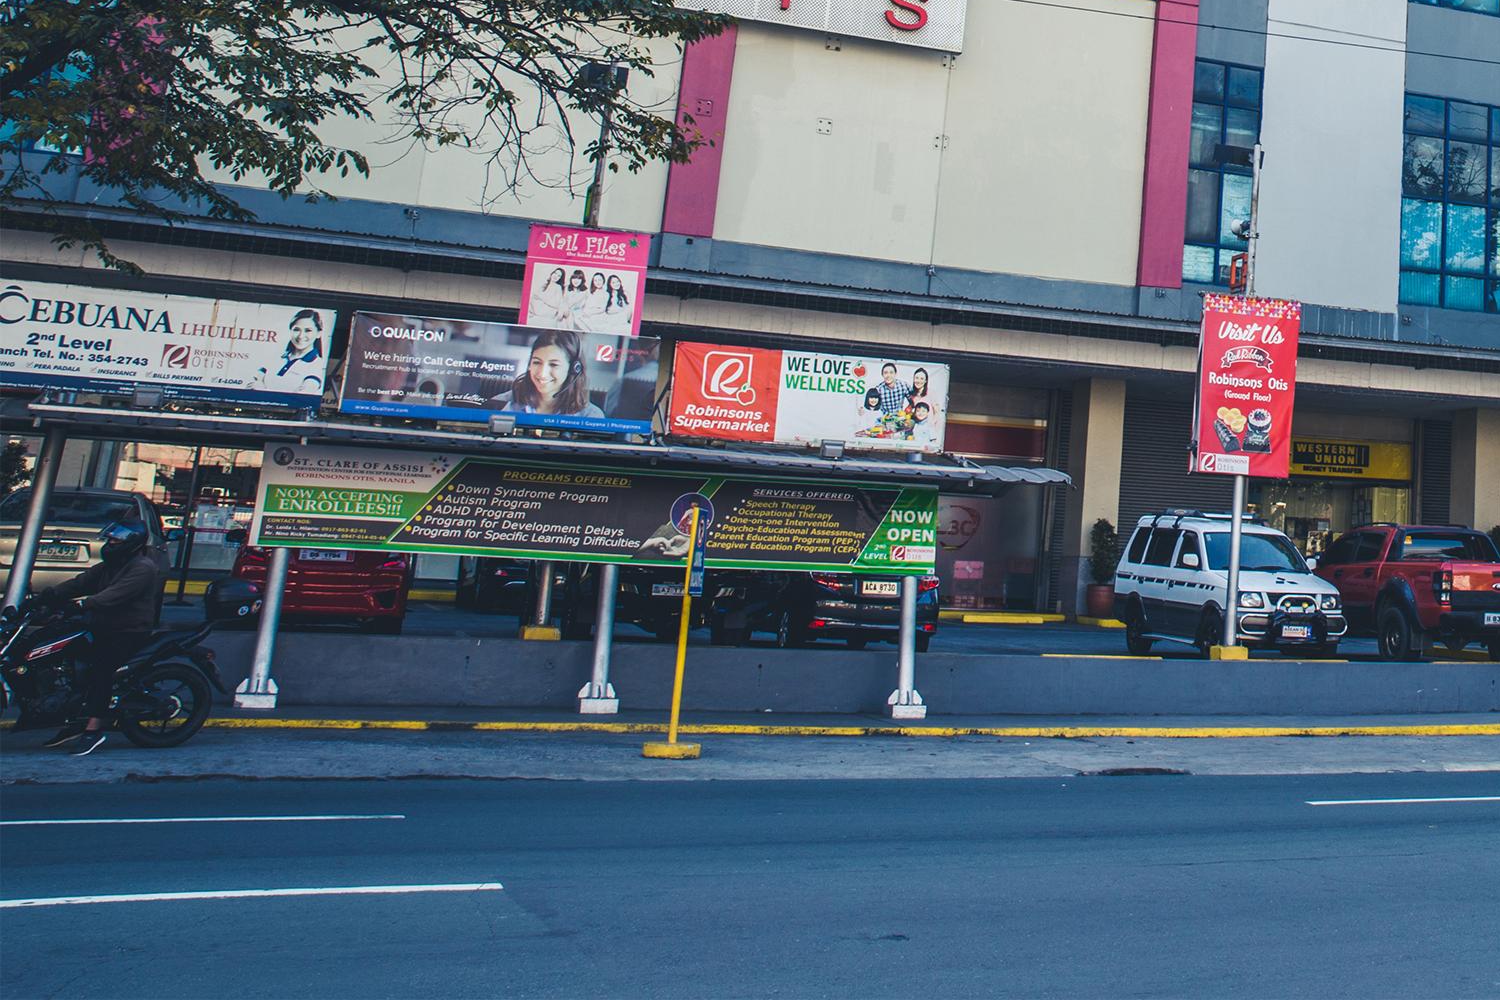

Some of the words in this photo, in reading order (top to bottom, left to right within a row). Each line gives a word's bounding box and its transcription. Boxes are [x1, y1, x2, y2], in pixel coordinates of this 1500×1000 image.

[540, 232, 579, 252] Nail
[585, 236, 627, 256] Files
[382, 326, 444, 343] QUALFON
[1218, 320, 1262, 341] Visit
[1262, 324, 1285, 344] Us
[26, 333, 56, 345] 2nd
[58, 335, 112, 352] Level
[33, 349, 54, 359] Tel.
[59, 351, 84, 361] No.:
[88, 353, 149, 367] 354-2743
[194, 349, 249, 360] ROBINSONS
[364, 351, 391, 362] We're
[393, 353, 421, 366] hiring
[423, 356, 443, 366] Call
[445, 358, 479, 369] Center
[480, 361, 515, 374] Agents
[97, 368, 137, 377] INSURANCE
[787, 356, 810, 374] WE
[814, 358, 851, 376] LOVE
[785, 373, 866, 395] WELLNESS
[1209, 371, 1263, 389] Robinsons
[1268, 377, 1288, 391] Otis
[685, 404, 762, 420] Robinsons
[674, 415, 770, 433] Supermarket
[1296, 443, 1356, 455] WESTERN
[317, 460, 360, 469] CLARE
[363, 461, 380, 470] OF
[385, 462, 424, 473] ASSISI
[1315, 455, 1355, 465] UNION
[295, 472, 351, 480] ROBINSONS
[378, 476, 416, 484] MANILA
[503, 470, 573, 484] PROGRAMS
[575, 475, 631, 487] OFFERED:
[275, 487, 314, 499] NOW
[317, 489, 404, 503] ACCEPTING
[456, 484, 490, 495] Down
[494, 486, 556, 500] Syndrome
[560, 490, 609, 503] Program
[753, 488, 803, 498] SERVICES
[806, 491, 854, 500] OFFERED:
[279, 498, 401, 516] ENROLLEES!!!
[443, 494, 486, 506] Autism
[491, 497, 542, 510] Program
[746, 500, 778, 509] Speech
[781, 501, 816, 511] Therapy
[433, 504, 471, 516] ADHD
[475, 507, 526, 519] Program
[738, 508, 797, 518] Occupational
[798, 510, 833, 520] Therapy
[890, 510, 933, 524] NOW
[424, 515, 476, 527] Program
[480, 518, 498, 528] for
[502, 520, 582, 537] Development
[585, 524, 624, 537] Delays
[722, 524, 809, 535] Psycho-Educational
[730, 515, 783, 525] One-on-one
[785, 518, 839, 528] Intervention
[411, 525, 461, 538] Program
[465, 528, 482, 539] for
[484, 530, 529, 542] Specific
[531, 532, 580, 546] Learning
[583, 534, 640, 549] Difficulties
[714, 533, 744, 541] Parent
[746, 534, 790, 542] Education
[792, 535, 829, 545] Program
[887, 528, 934, 543] OPEN
[706, 541, 748, 550] Caregiver
[750, 542, 792, 551] Education
[794, 544, 832, 553] Program
